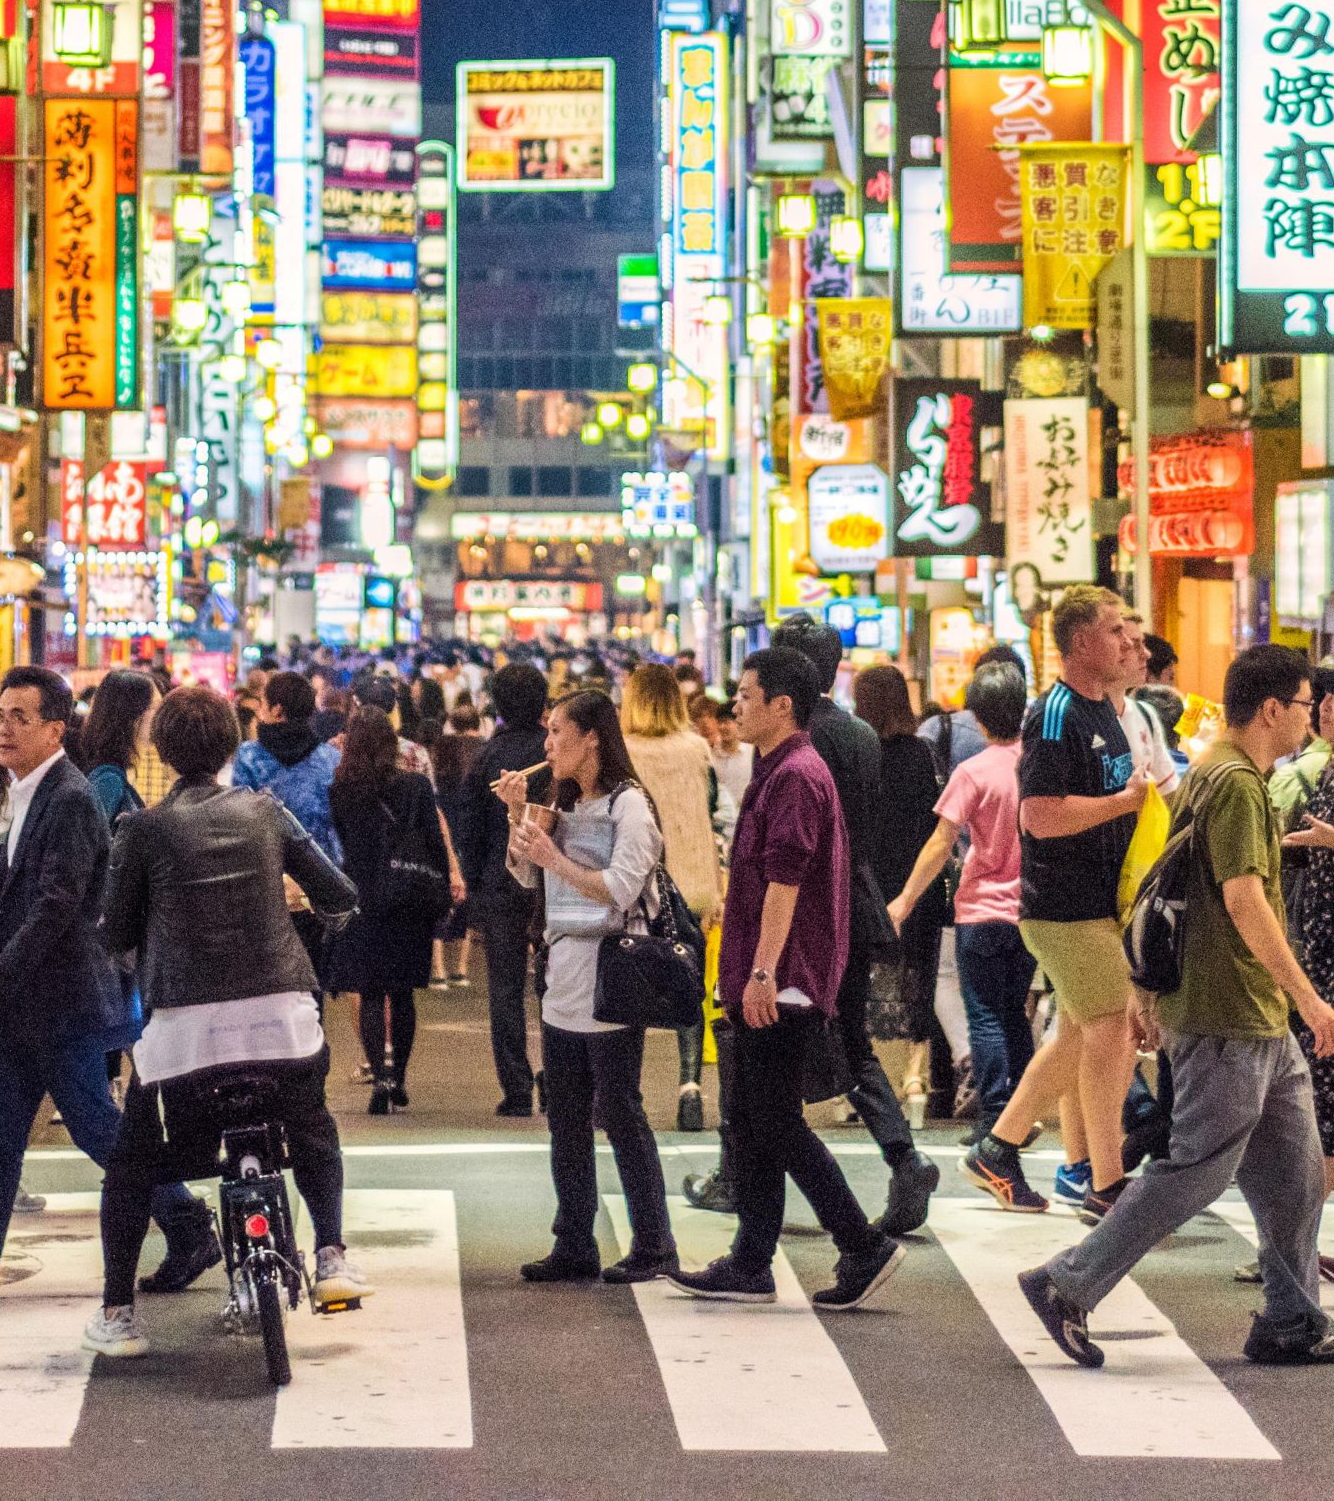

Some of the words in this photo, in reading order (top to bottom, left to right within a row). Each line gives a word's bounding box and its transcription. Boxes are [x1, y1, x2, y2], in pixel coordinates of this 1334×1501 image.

[1030, 161, 1118, 190] 悪質な
[1031, 195, 1116, 223] 客引き
[1031, 227, 1119, 256] に注意
[1035, 414, 1087, 564] お好み焼き
